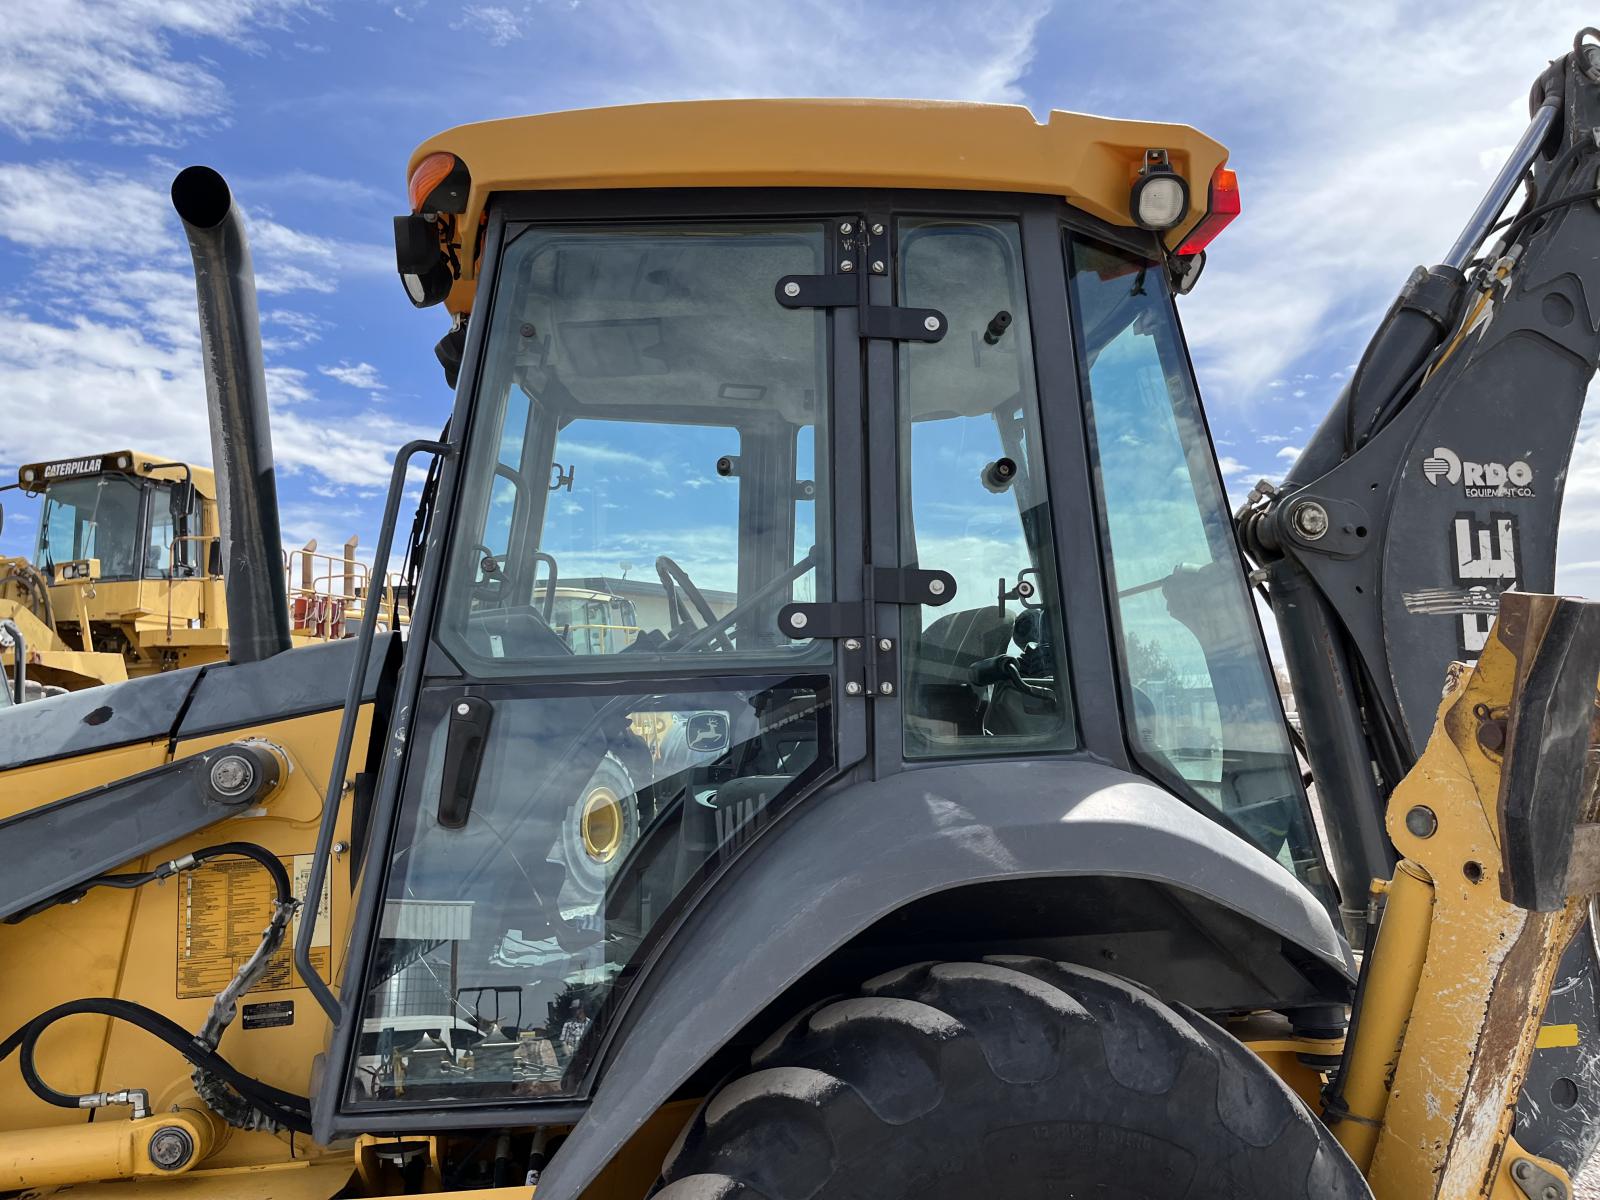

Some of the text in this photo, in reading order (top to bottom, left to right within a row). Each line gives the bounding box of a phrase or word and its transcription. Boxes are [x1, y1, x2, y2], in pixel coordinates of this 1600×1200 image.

[44, 459, 102, 477] CATERPILLAR
[1463, 461, 1533, 487] RDO
[1466, 488, 1516, 498] EQUIPMNT
